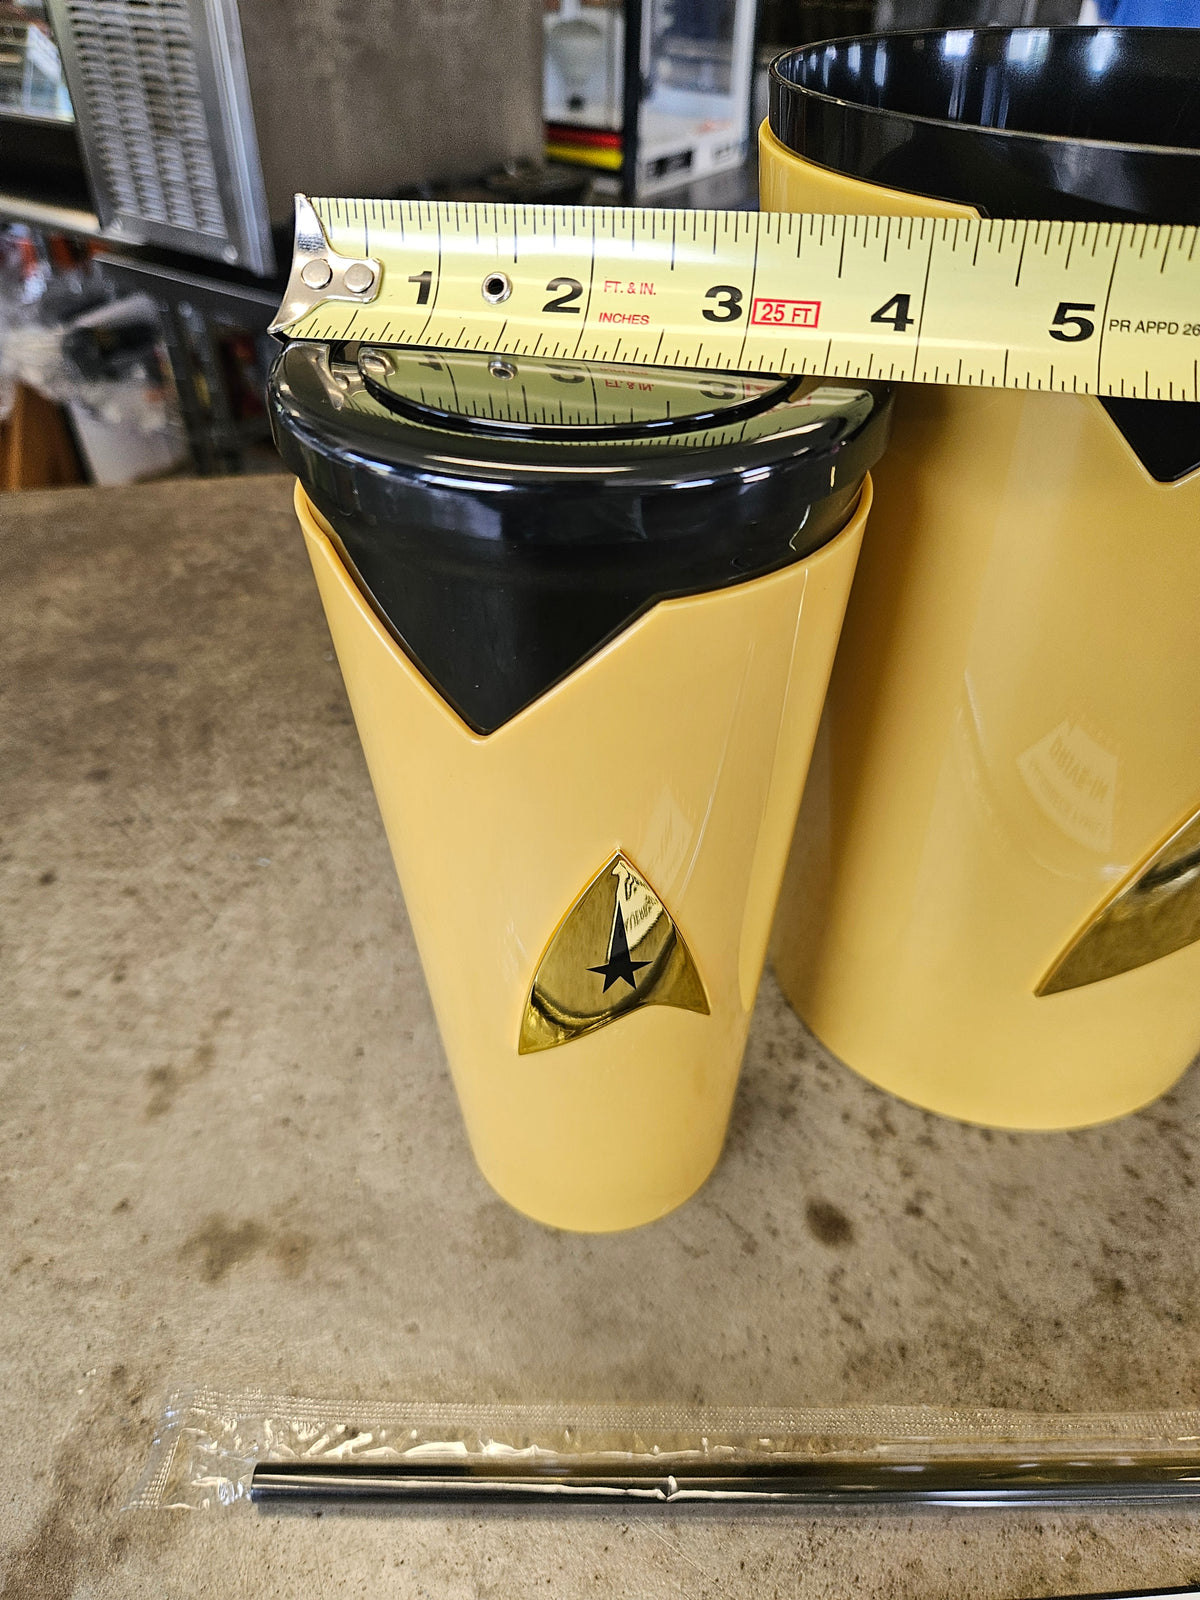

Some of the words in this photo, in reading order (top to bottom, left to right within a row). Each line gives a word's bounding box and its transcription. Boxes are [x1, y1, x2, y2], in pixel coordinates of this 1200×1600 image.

[408, 270, 433, 305] 1
[541, 277, 584, 314] 2
[603, 280, 624, 293] FT.
[639, 282, 657, 296] IN.
[701, 284, 743, 323] 3
[598, 311, 651, 326] INCHES
[760, 303, 786, 322] 25
[791, 307, 813, 323] FT
[870, 292, 915, 332] 4
[1048, 301, 1096, 342] 5
[1108, 318, 1132, 333] PR
[1134, 320, 1180, 335] APPD
